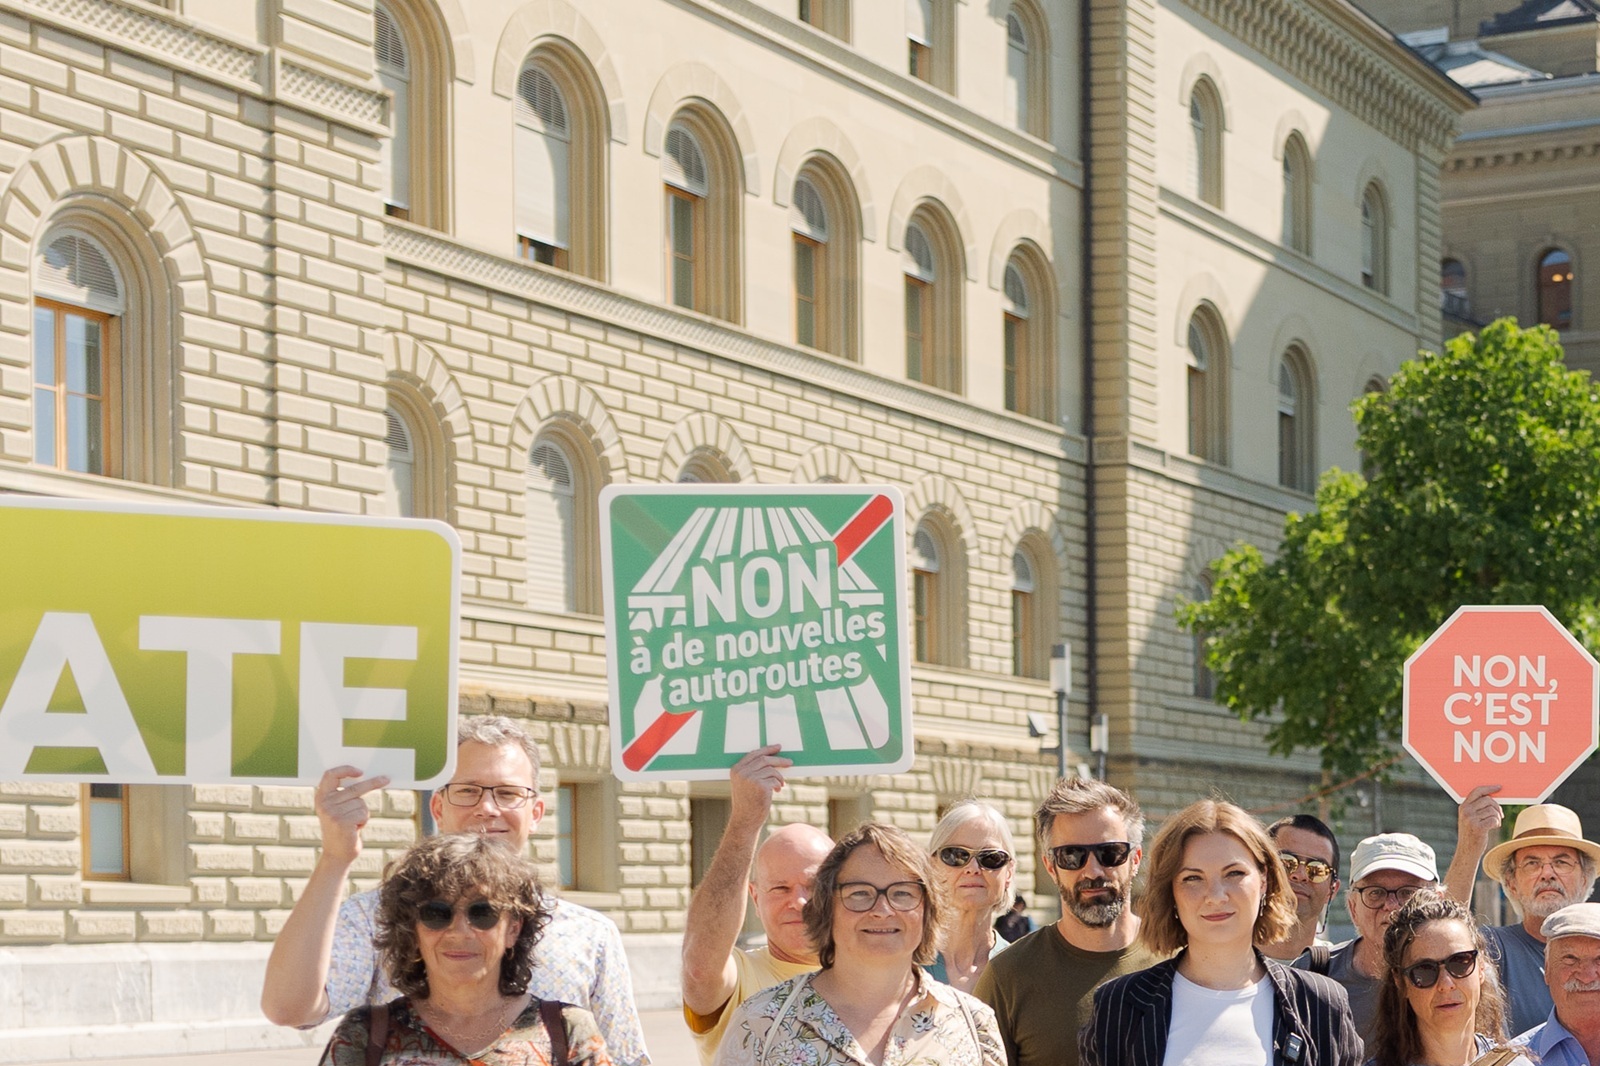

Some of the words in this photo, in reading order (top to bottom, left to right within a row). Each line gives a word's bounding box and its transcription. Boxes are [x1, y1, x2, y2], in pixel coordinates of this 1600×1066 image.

[692, 548, 832, 628] NON
[630, 636, 651, 674] à
[662, 632, 704, 670] de
[716, 608, 886, 662] nouvelles
[0, 611, 418, 782] ATE
[668, 652, 862, 707] autoroutes
[1454, 655, 1558, 694] NON,
[1443, 692, 1558, 726] C'EST
[1453, 730, 1546, 763] NON
